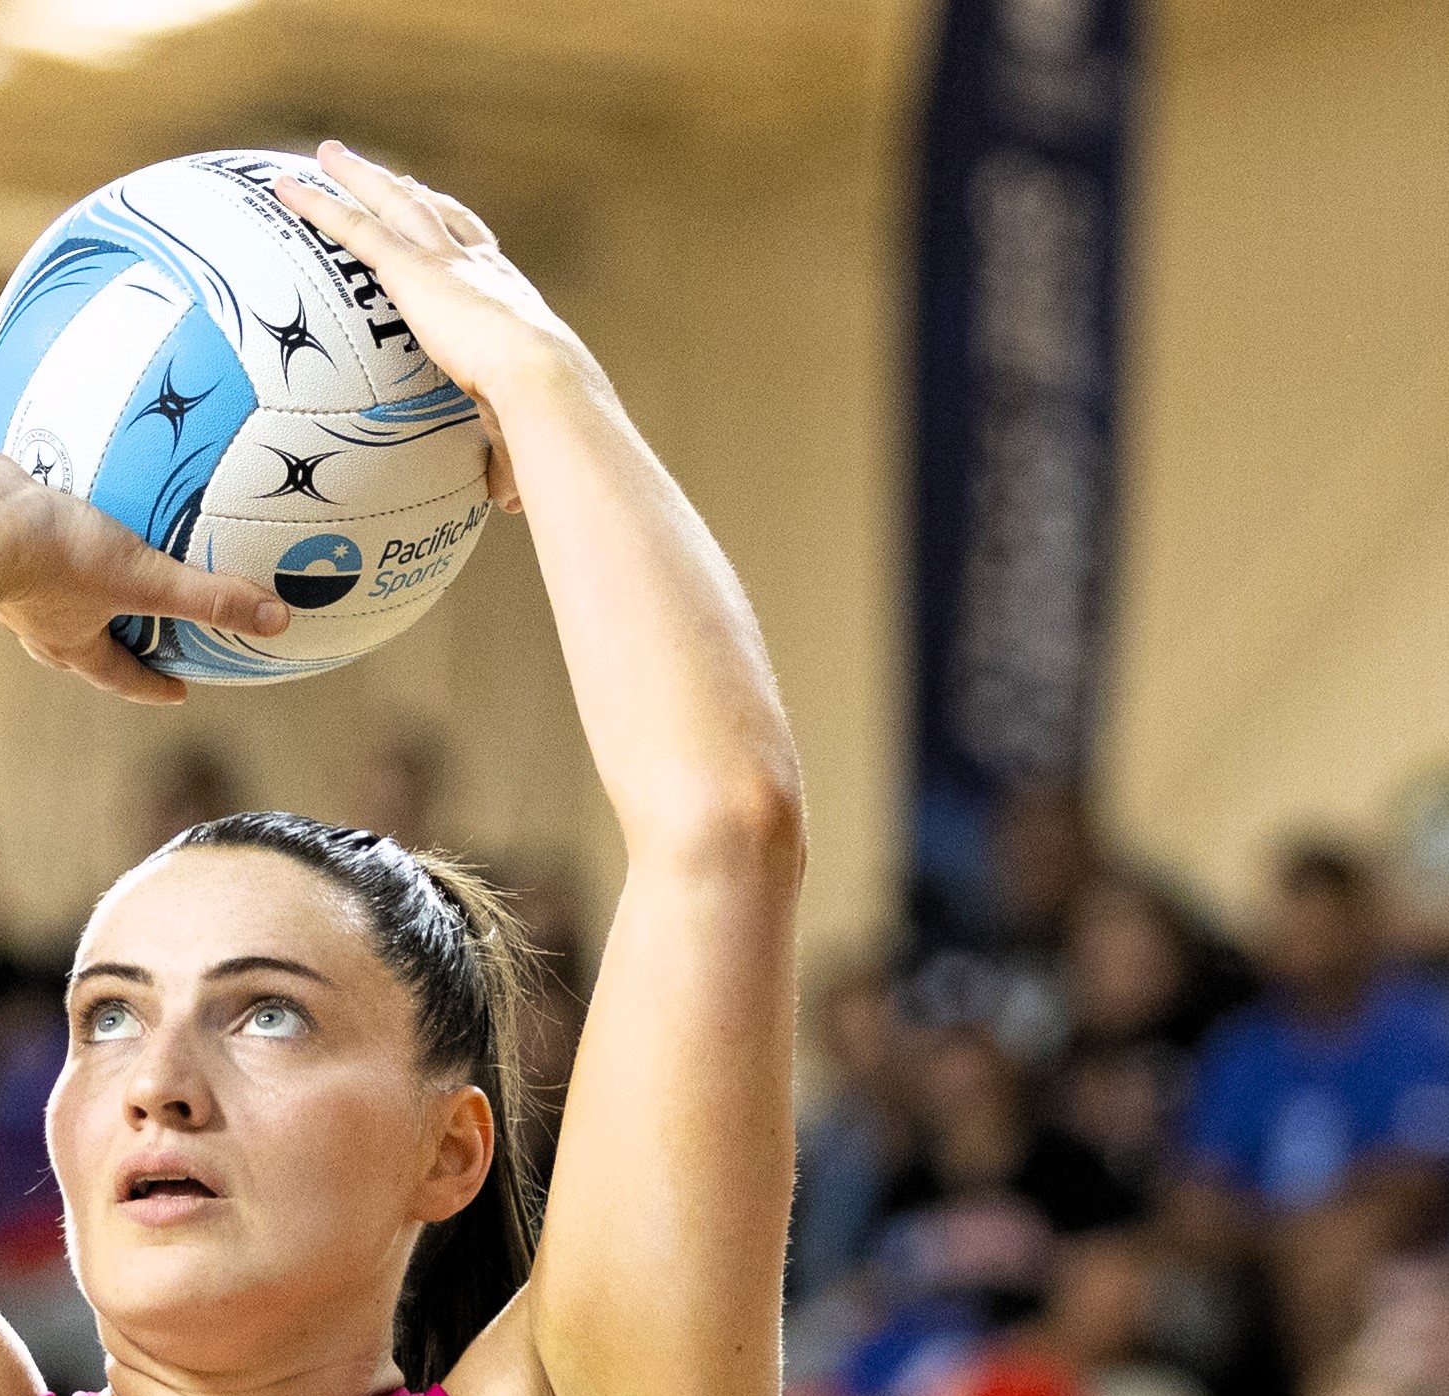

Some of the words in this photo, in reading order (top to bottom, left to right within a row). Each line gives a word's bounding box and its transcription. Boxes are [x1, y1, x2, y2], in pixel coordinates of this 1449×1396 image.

[243, 196, 276, 223] SIZE
[280, 229, 293, 241] 5
[295, 228, 317, 250] Super
[313, 249, 339, 278] Netball
[332, 277, 355, 310] League
[367, 552, 455, 600] Sports
